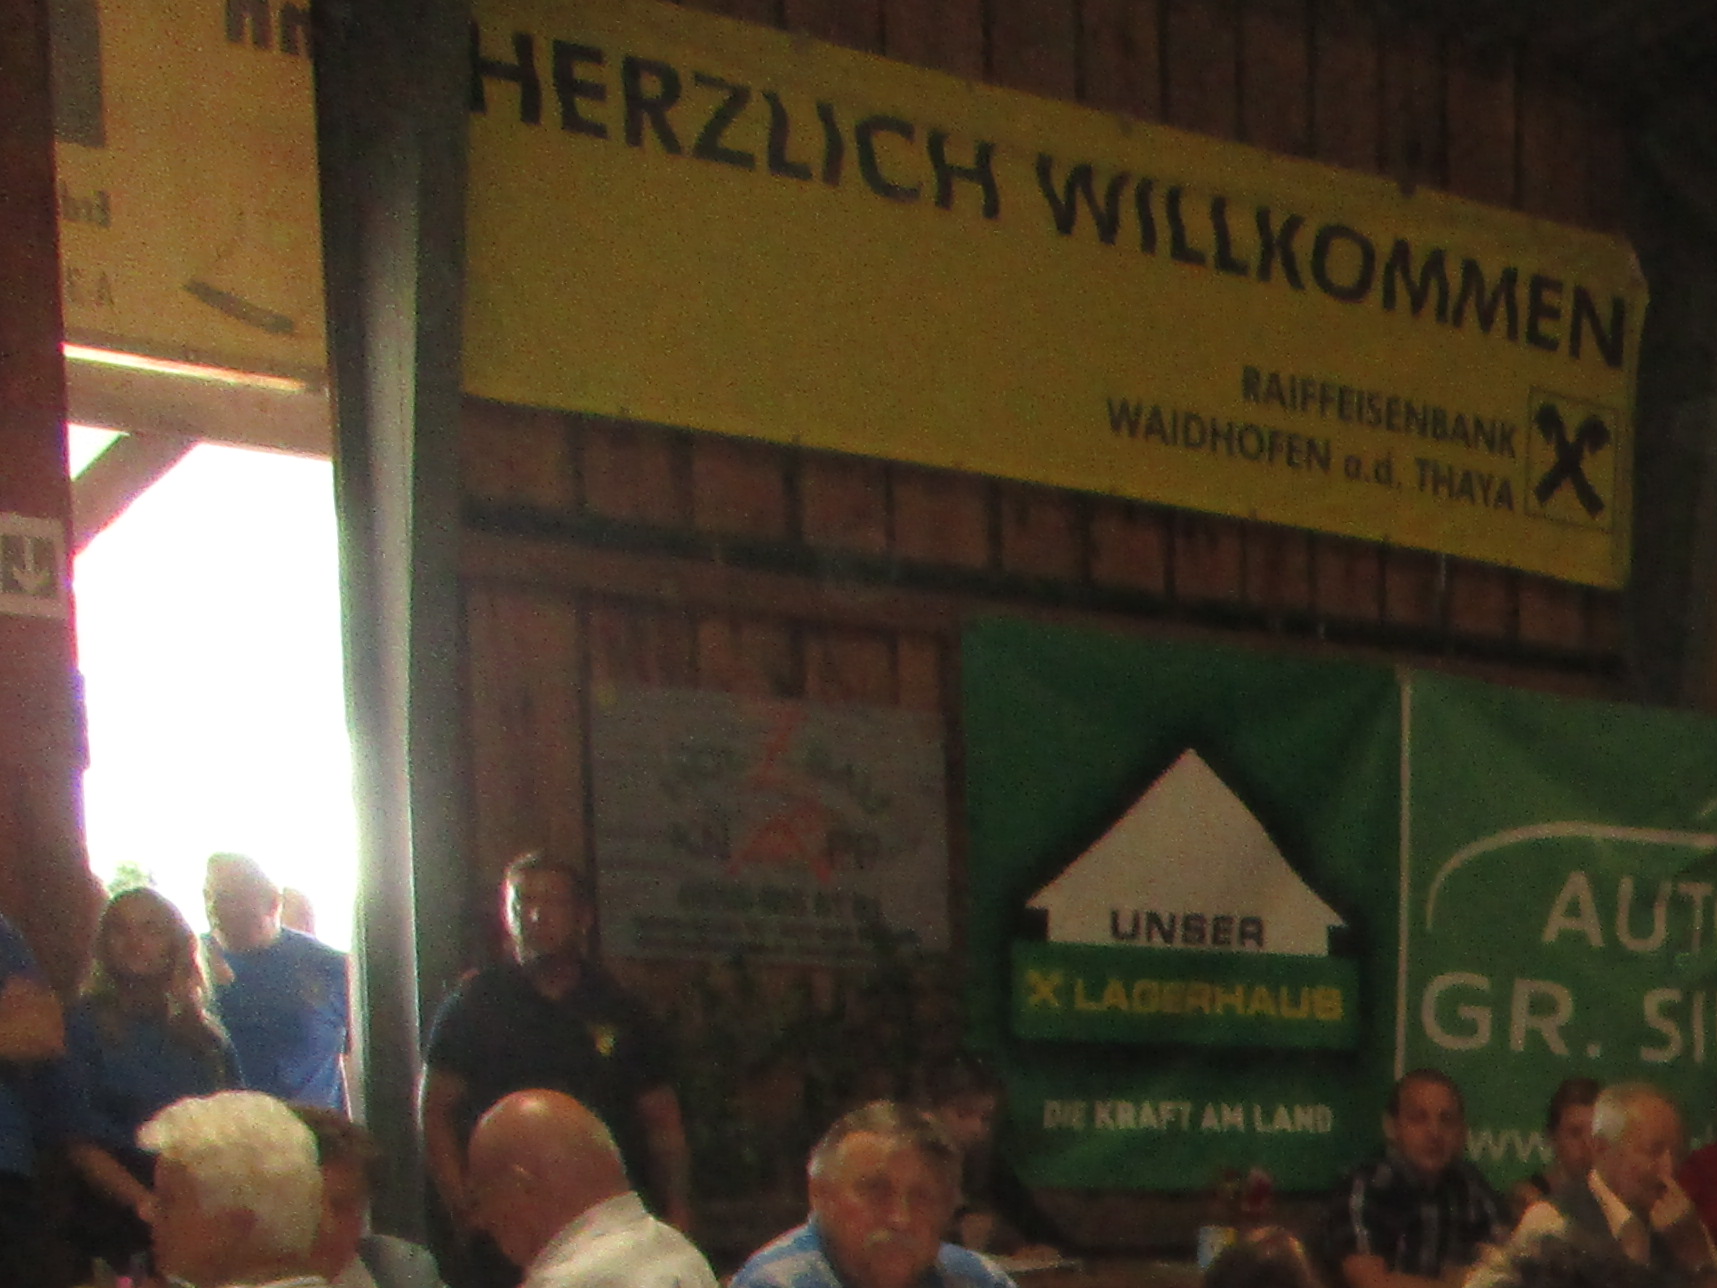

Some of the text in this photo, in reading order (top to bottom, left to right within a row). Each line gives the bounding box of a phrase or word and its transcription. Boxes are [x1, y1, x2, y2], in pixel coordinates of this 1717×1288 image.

[469, 14, 1627, 368] HERZLICH WILLKOMMEN
[1105, 397, 1332, 472] WAIDHOFEN
[1414, 457, 1516, 511] THAYA
[1241, 364, 1518, 459] RAIFFEISENBANK
[1111, 911, 1265, 948] UNSER
[1073, 977, 1345, 1022] LAGERHAUS
[1419, 970, 1604, 1061] GR.
[1041, 1098, 1336, 1135] DIE KRAFT AM LAND
